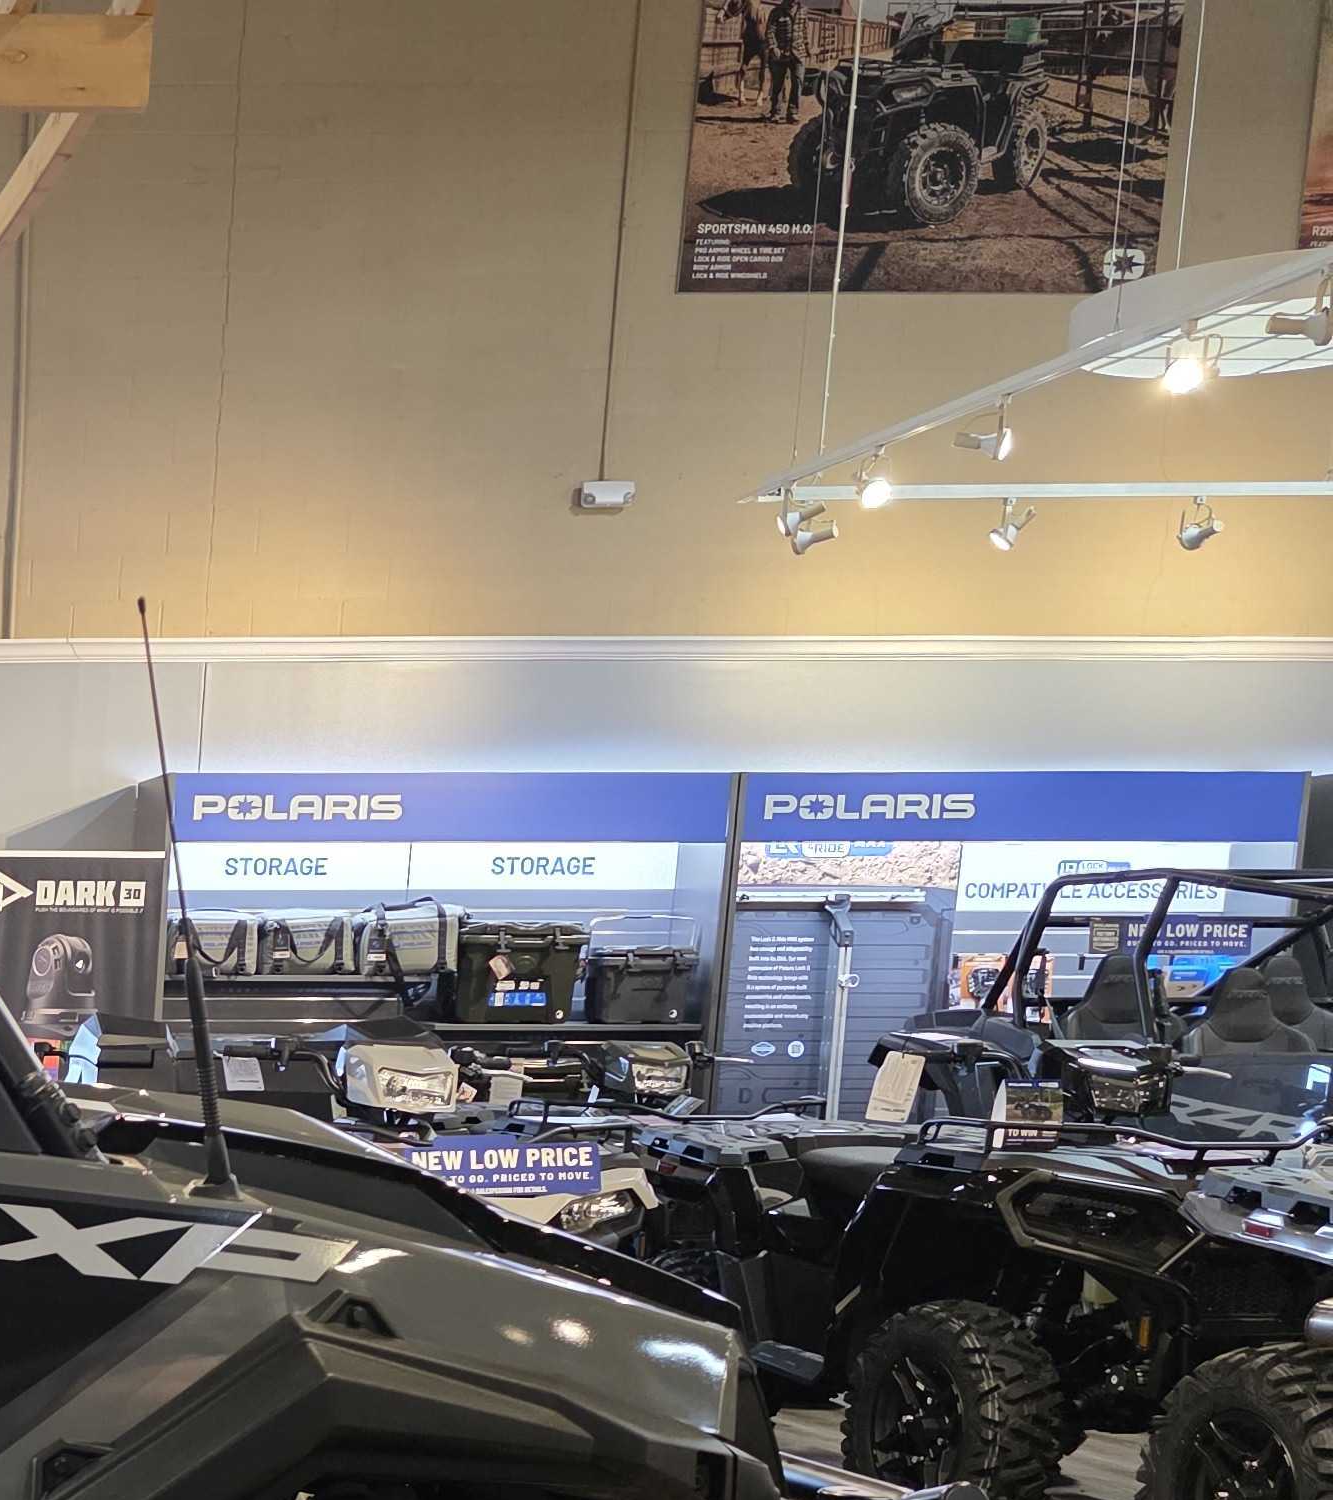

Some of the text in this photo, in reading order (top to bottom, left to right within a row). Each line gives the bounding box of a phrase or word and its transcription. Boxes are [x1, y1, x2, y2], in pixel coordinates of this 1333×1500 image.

[697, 223, 766, 235] SPORTSMAN
[768, 223, 790, 235] 450
[192, 794, 403, 821] POLARIS
[763, 793, 976, 820] POLARIS
[224, 858, 328, 876] STORAGE
[491, 857, 596, 876] STORAGE
[35, 880, 116, 906] DARK
[965, 882, 1218, 899] COMPATLE ACCESSRIES
[1166, 924, 1199, 938] LOW
[1203, 924, 1248, 938] PRICE
[411, 1146, 593, 1172] NEW LOW PRICE
[493, 1173, 535, 1183] PRICED
[541, 1172, 554, 1181] TO
[559, 1171, 594, 1181] MOVE.
